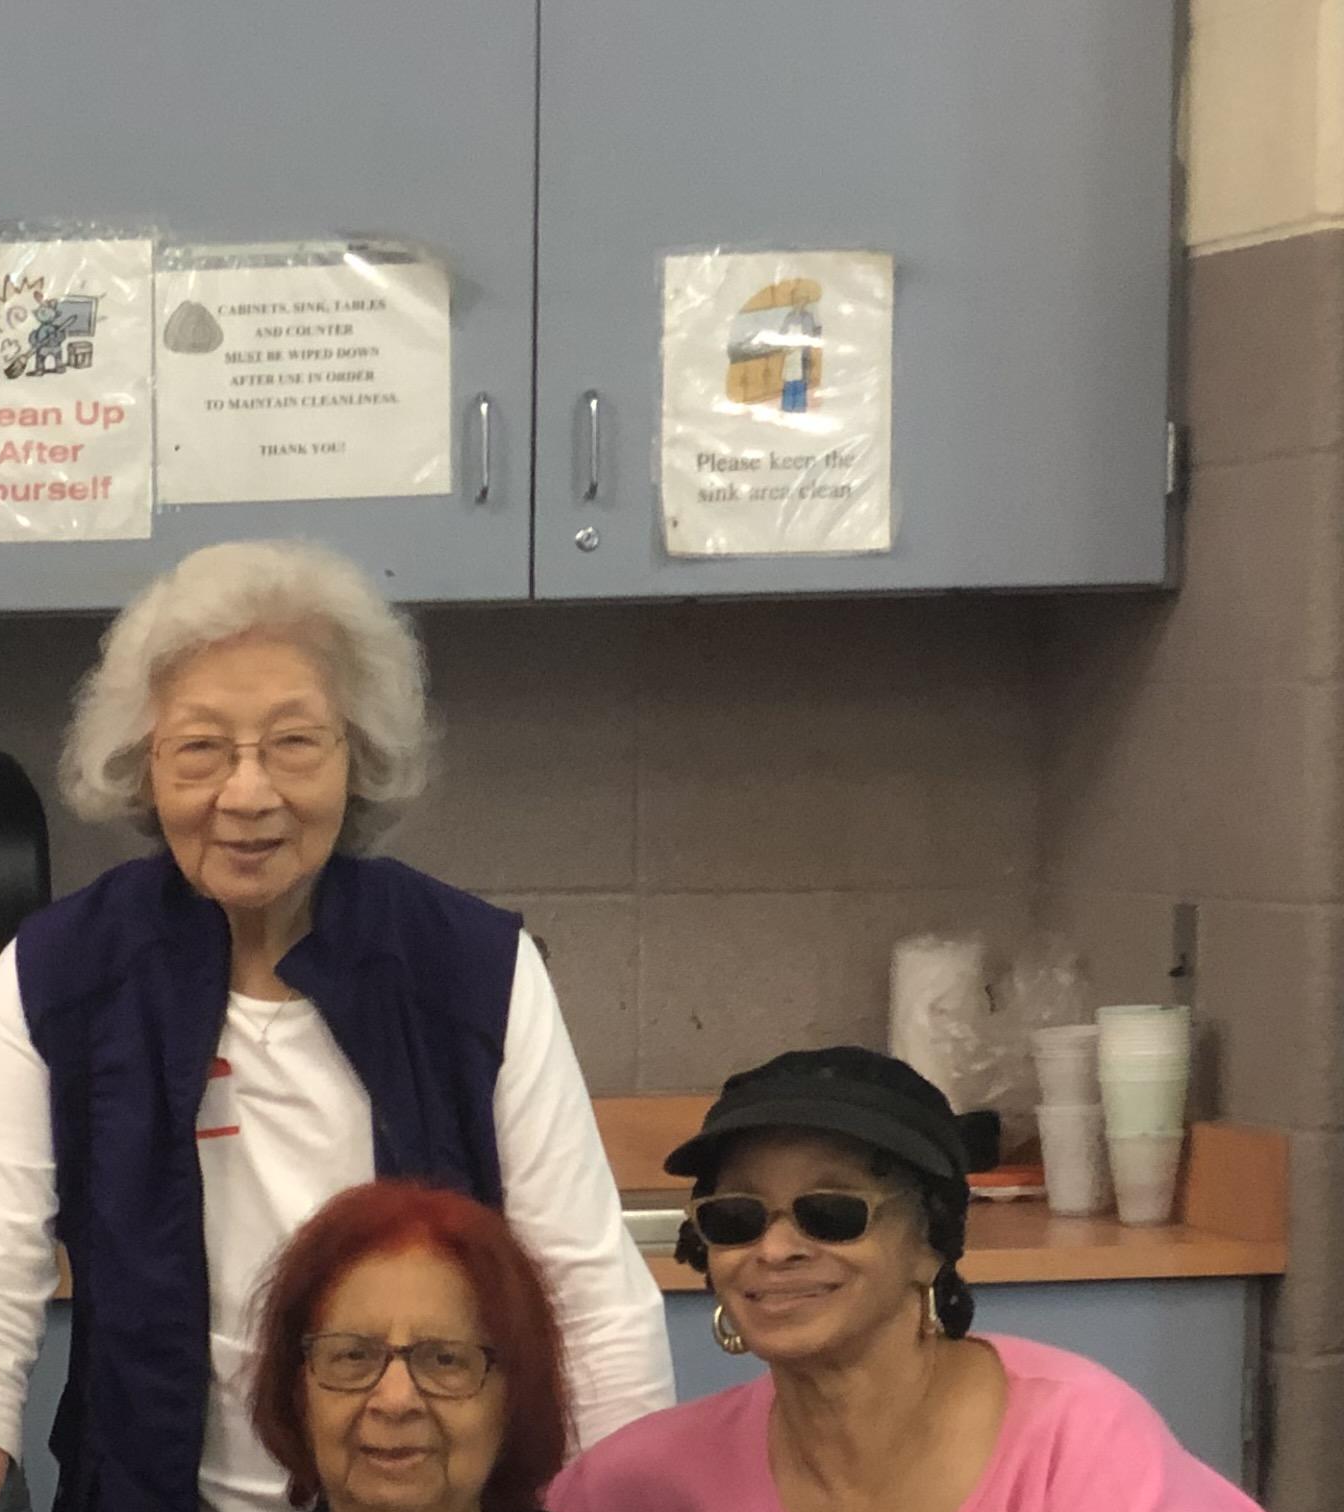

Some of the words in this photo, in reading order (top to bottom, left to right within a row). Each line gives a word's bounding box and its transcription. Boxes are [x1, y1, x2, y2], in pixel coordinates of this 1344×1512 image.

[334, 299, 387, 313] TABLES
[254, 326, 283, 338] AND
[286, 324, 354, 338] COUNTER
[224, 351, 263, 364] MUST
[266, 350, 286, 362] BE
[288, 348, 333, 361] WIPED
[336, 347, 380, 358] DOWN
[229, 373, 275, 387] AFTER
[278, 372, 304, 384] USE
[307, 371, 323, 383] IN
[326, 370, 375, 383] ORDER
[204, 399, 224, 411] TO
[227, 396, 298, 410] MAINTAIN
[75, 400, 125, 430] Up
[259, 443, 307, 456] THANK
[696, 453, 761, 473] Please
[824, 451, 855, 469] the
[696, 484, 740, 503] sink
[748, 486, 789, 501] area
[798, 482, 852, 501] clean
